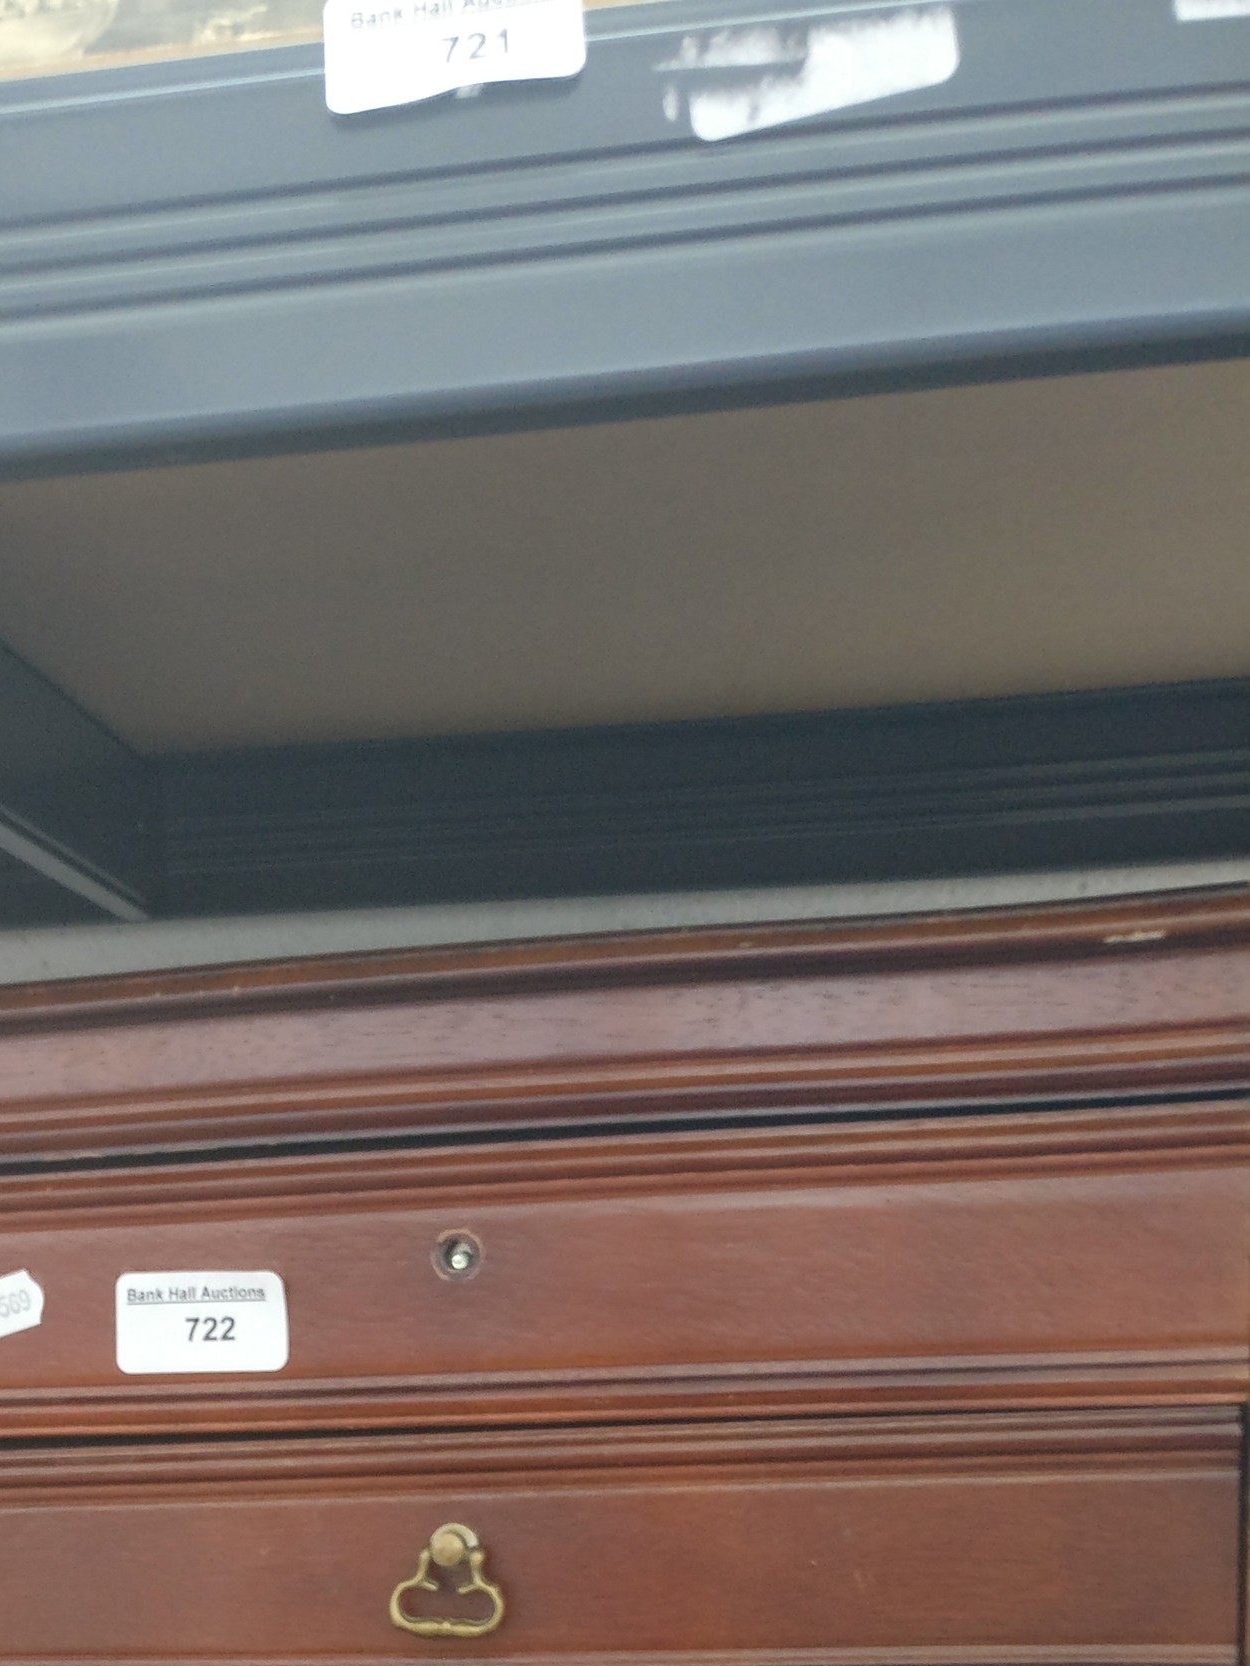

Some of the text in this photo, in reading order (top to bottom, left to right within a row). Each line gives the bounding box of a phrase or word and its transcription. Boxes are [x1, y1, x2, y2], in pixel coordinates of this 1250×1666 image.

[350, 7, 403, 29] Bank
[413, 0, 453, 17] Hall
[441, 28, 509, 63] 721
[126, 1285, 266, 1302] Bank Hall Auctions
[185, 1316, 236, 1342] 722
